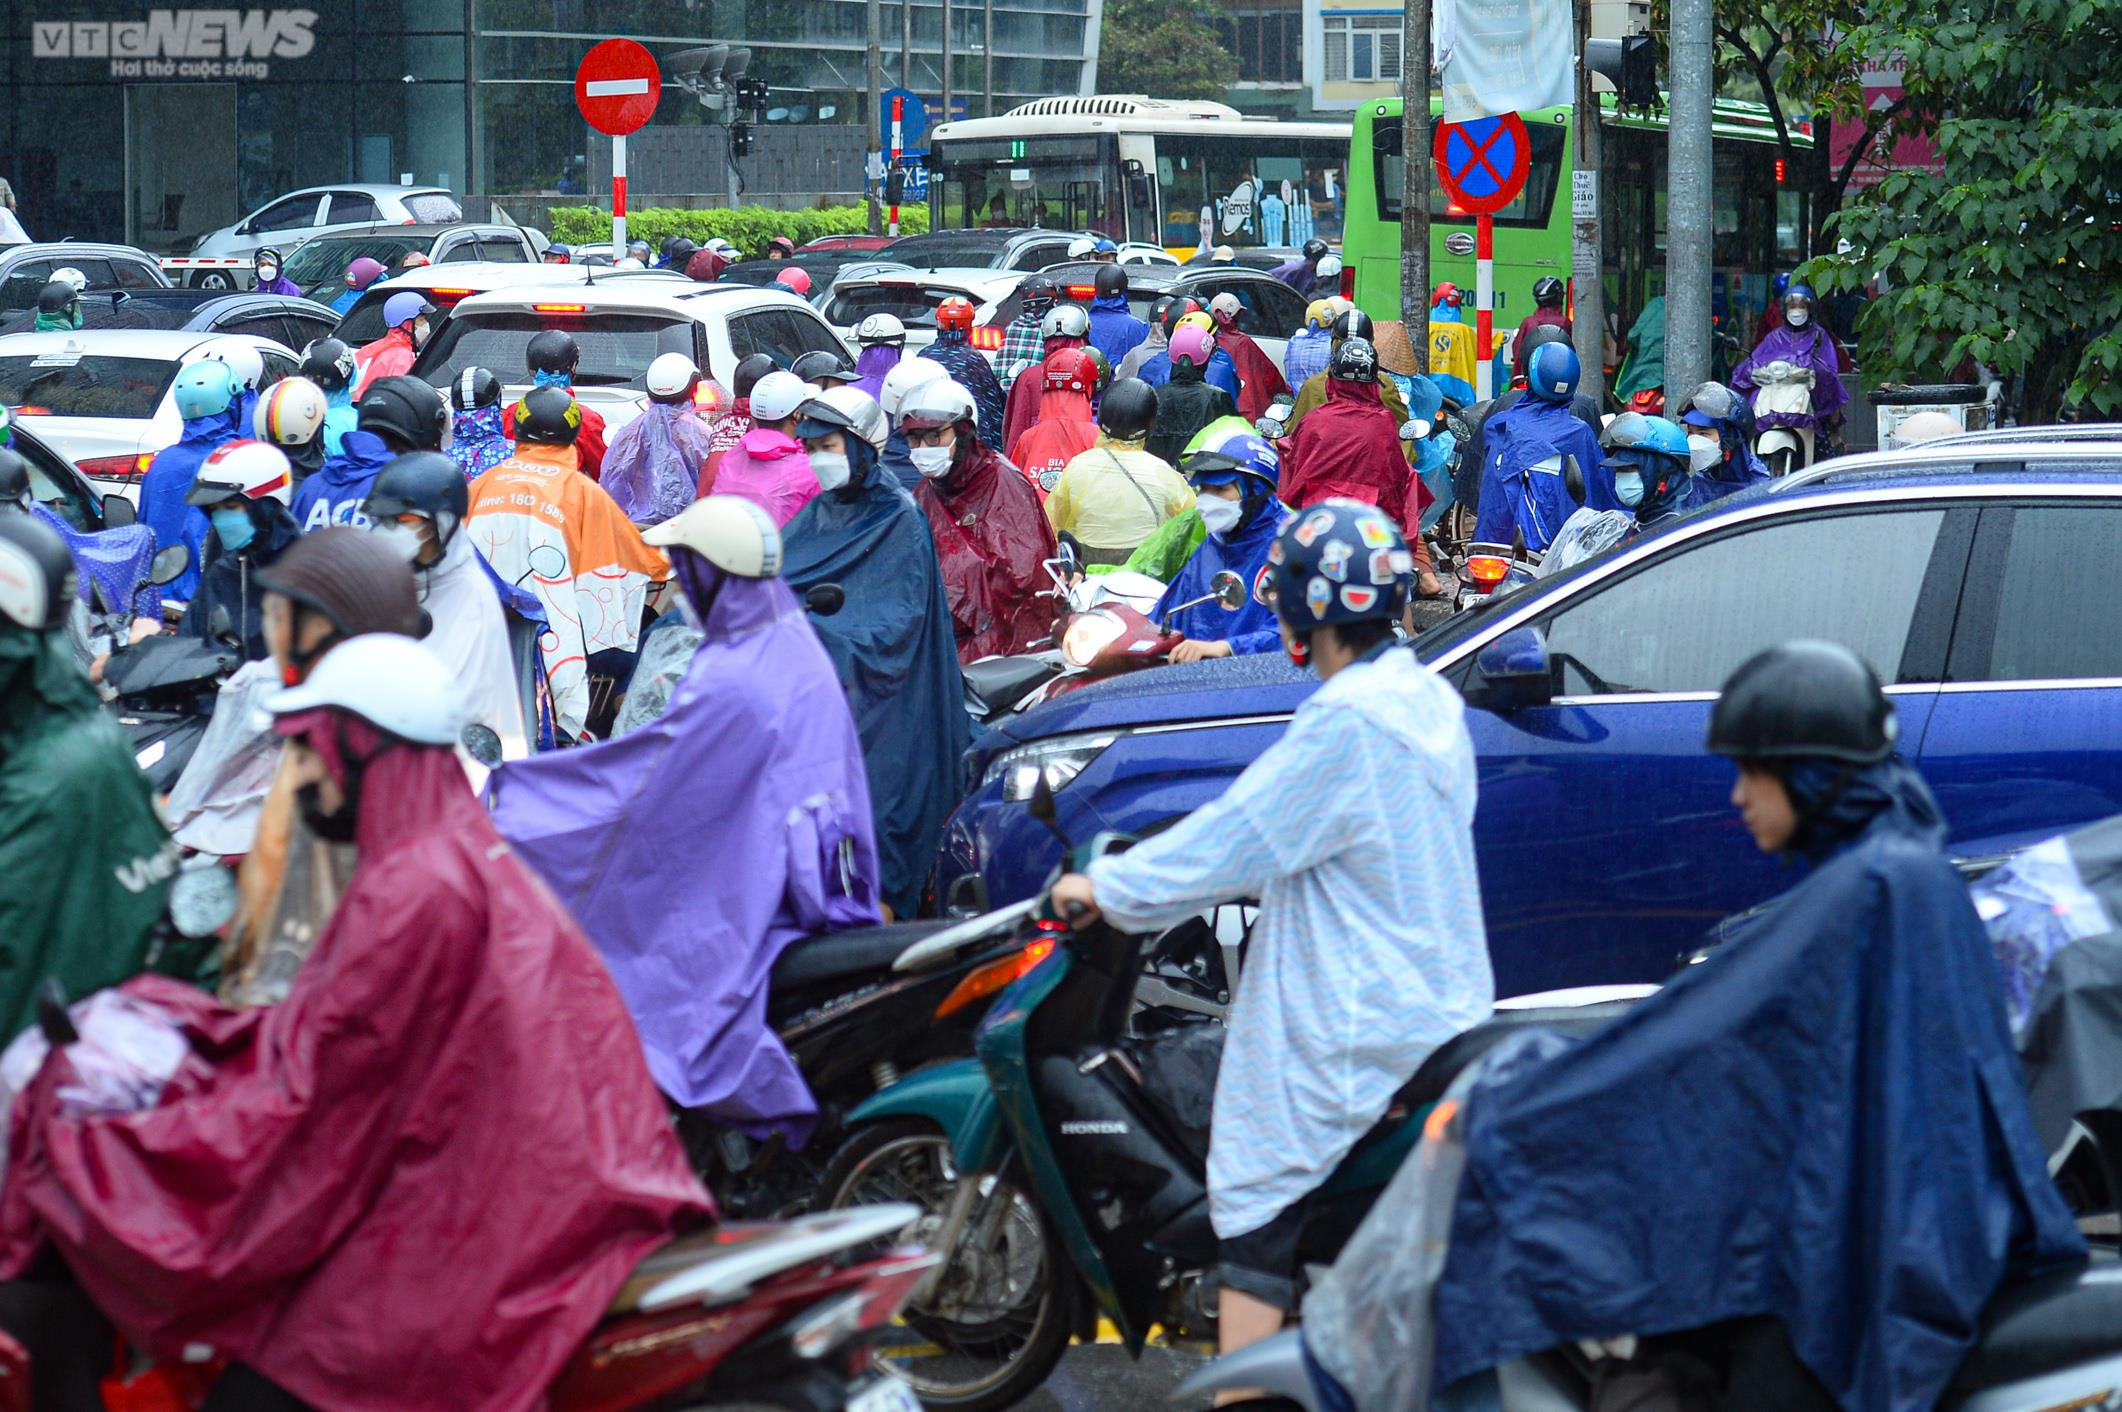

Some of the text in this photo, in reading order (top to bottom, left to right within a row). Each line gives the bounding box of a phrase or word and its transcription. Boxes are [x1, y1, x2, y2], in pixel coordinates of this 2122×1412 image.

[1223, 198, 1250, 216] Remos
[1048, 458, 1064, 467] BIA
[1060, 1121, 1128, 1135] HONDA
